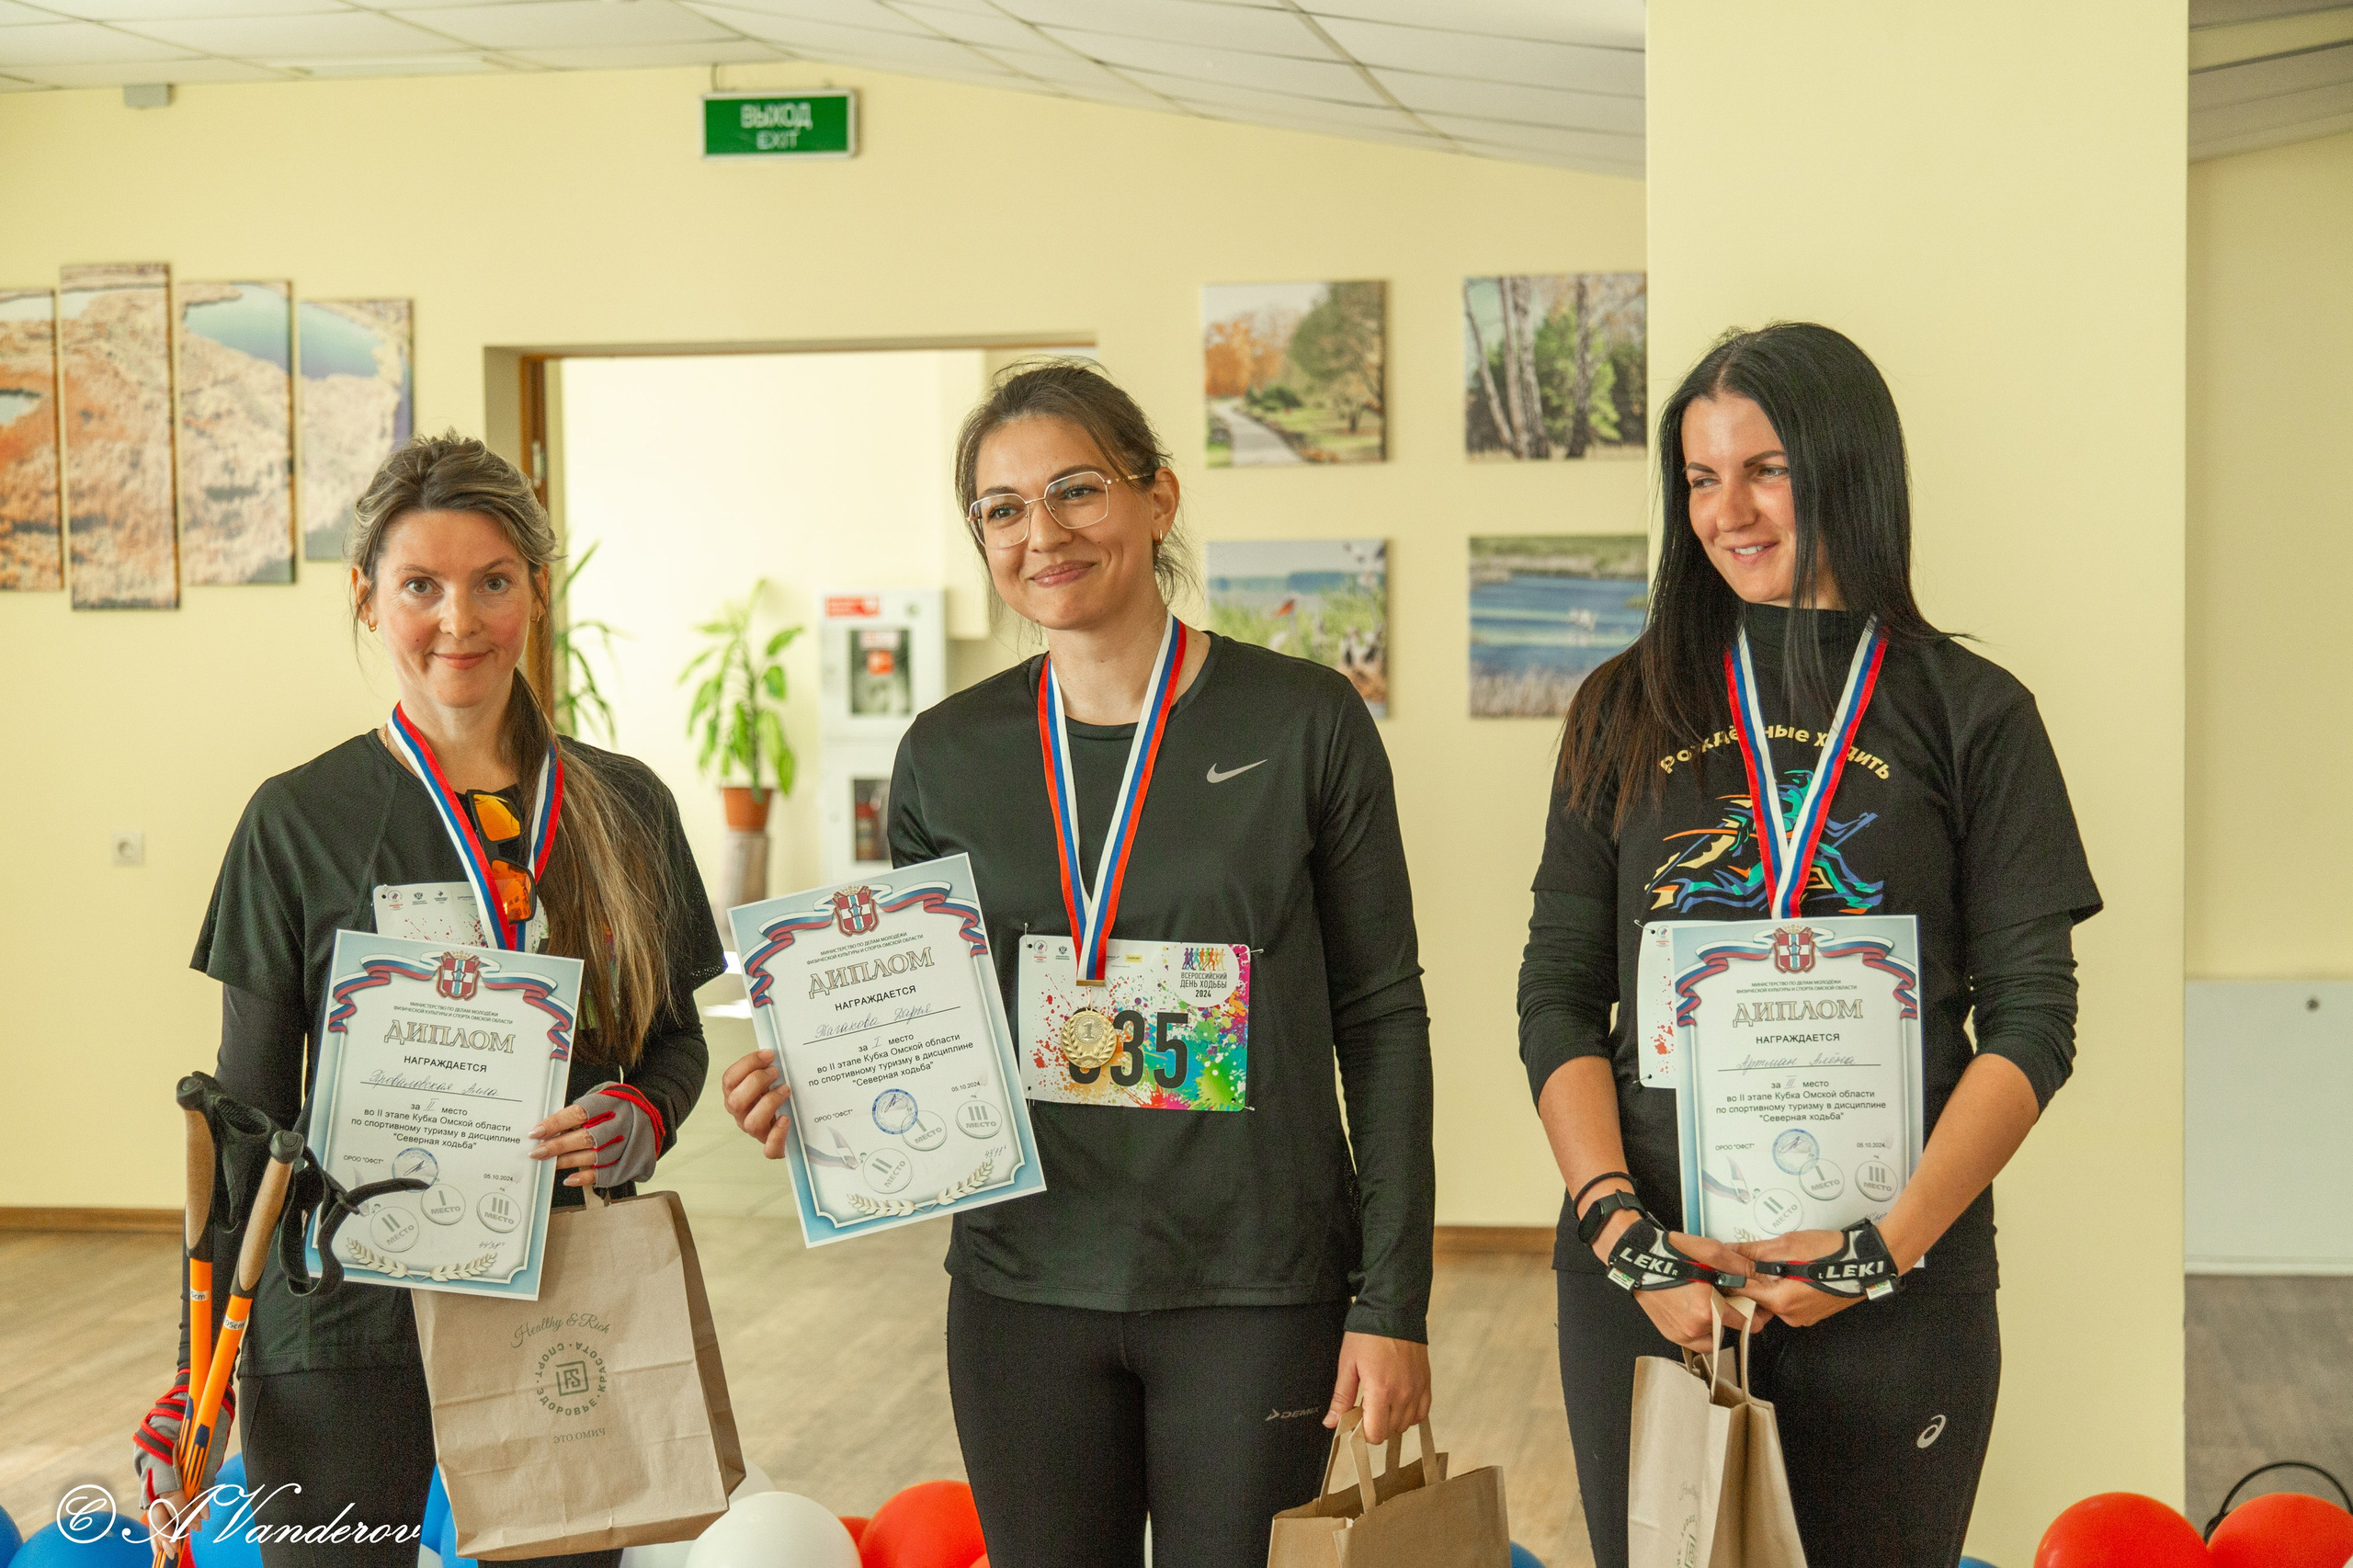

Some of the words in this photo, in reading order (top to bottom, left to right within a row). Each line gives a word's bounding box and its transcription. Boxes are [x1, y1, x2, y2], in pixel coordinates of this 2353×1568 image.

[741, 103, 813, 131] ВЫХОД
[756, 128, 800, 149] EXIT
[1813, 732, 1890, 779] хдить
[807, 954, 837, 965] ФИЗИЧЕСКОЙ
[838, 949, 860, 959] КУЛЬТУРЫ
[882, 939, 902, 948] ОМСКОЙ
[903, 935, 924, 943] ОБЛАСТИ
[821, 944, 856, 956] МИНИСТЕРСТВО
[809, 947, 935, 999] ДИПЛОМ
[1180, 980, 1198, 988] ДЕНЬ
[1199, 980, 1226, 989] ХОДЬБЫ
[410, 1002, 447, 1011] МИНИСТЕРСТВО
[835, 985, 916, 1011] НАГРАЖДАЕТСЯ
[393, 1006, 425, 1014] ФИЗИЧЕСКОЙ
[1733, 999, 1863, 1028] ДИПЛОМ
[384, 1019, 516, 1053] ДИПЛОМ
[888, 1033, 914, 1045] место
[1084, 1022, 1094, 1039] 1
[1756, 1033, 1840, 1044] НАГРАЖДАЕТСЯ
[817, 1065, 827, 1074] во
[837, 1058, 861, 1069] этапе
[864, 1051, 888, 1064] Кубка
[891, 1041, 923, 1056] Омской
[926, 1034, 960, 1048] области
[404, 1056, 487, 1073] НАГРАЖДАЕТСЯ
[822, 1067, 876, 1085] спортивному
[879, 1057, 913, 1073] туризму
[923, 1041, 973, 1061] дисциплине
[853, 1072, 899, 1086] "Северная
[901, 1062, 934, 1076] ходьба"
[951, 1081, 981, 1092] 05.10.2024
[1776, 1092, 1800, 1101] Кубка
[1803, 1090, 1836, 1098] Омской
[441, 1107, 467, 1116] место
[814, 1114, 832, 1123] ОРОО
[833, 1109, 853, 1119] "ОФСТ"
[1729, 1104, 1785, 1113] спортивному
[1789, 1103, 1824, 1111] туризму
[385, 1111, 410, 1120] этапе
[413, 1114, 437, 1124] Кубка
[440, 1117, 472, 1128] Омской
[475, 1121, 511, 1132] области
[1759, 1115, 1806, 1123] "Северная
[1809, 1112, 1844, 1120] ходьба"
[364, 1120, 421, 1133] спортивному
[424, 1127, 458, 1138] туризму
[468, 1131, 520, 1144] дисциплине
[915, 1127, 942, 1143] МЕСТО
[393, 1133, 439, 1145] "Северная
[442, 1141, 477, 1150] ходьба"
[483, 1174, 513, 1182] 05.10.2024
[884, 1160, 905, 1187] МЕСТО
[1811, 1179, 1840, 1191] МЕСТО
[1863, 1182, 1893, 1192] МЕСТО
[431, 1206, 461, 1215] МЕСТО
[484, 1211, 515, 1225] МЕСТО
[1772, 1204, 1798, 1228] МЕСТО
[386, 1224, 415, 1245] МЕСТО
[1620, 1247, 1674, 1275] LEKI
[1825, 1261, 1883, 1278] LEKI
[511, 1316, 563, 1348] Healthy
[566, 1313, 578, 1326] &
[579, 1312, 610, 1334] Rich
[535, 1343, 564, 1378] СПОРТ
[575, 1341, 607, 1392] КРАСОТА
[537, 1387, 597, 1415] ЗДОРОВЬЕ
[553, 1434, 574, 1444] ЭТО
[575, 1428, 606, 1440] ОМИЧ
